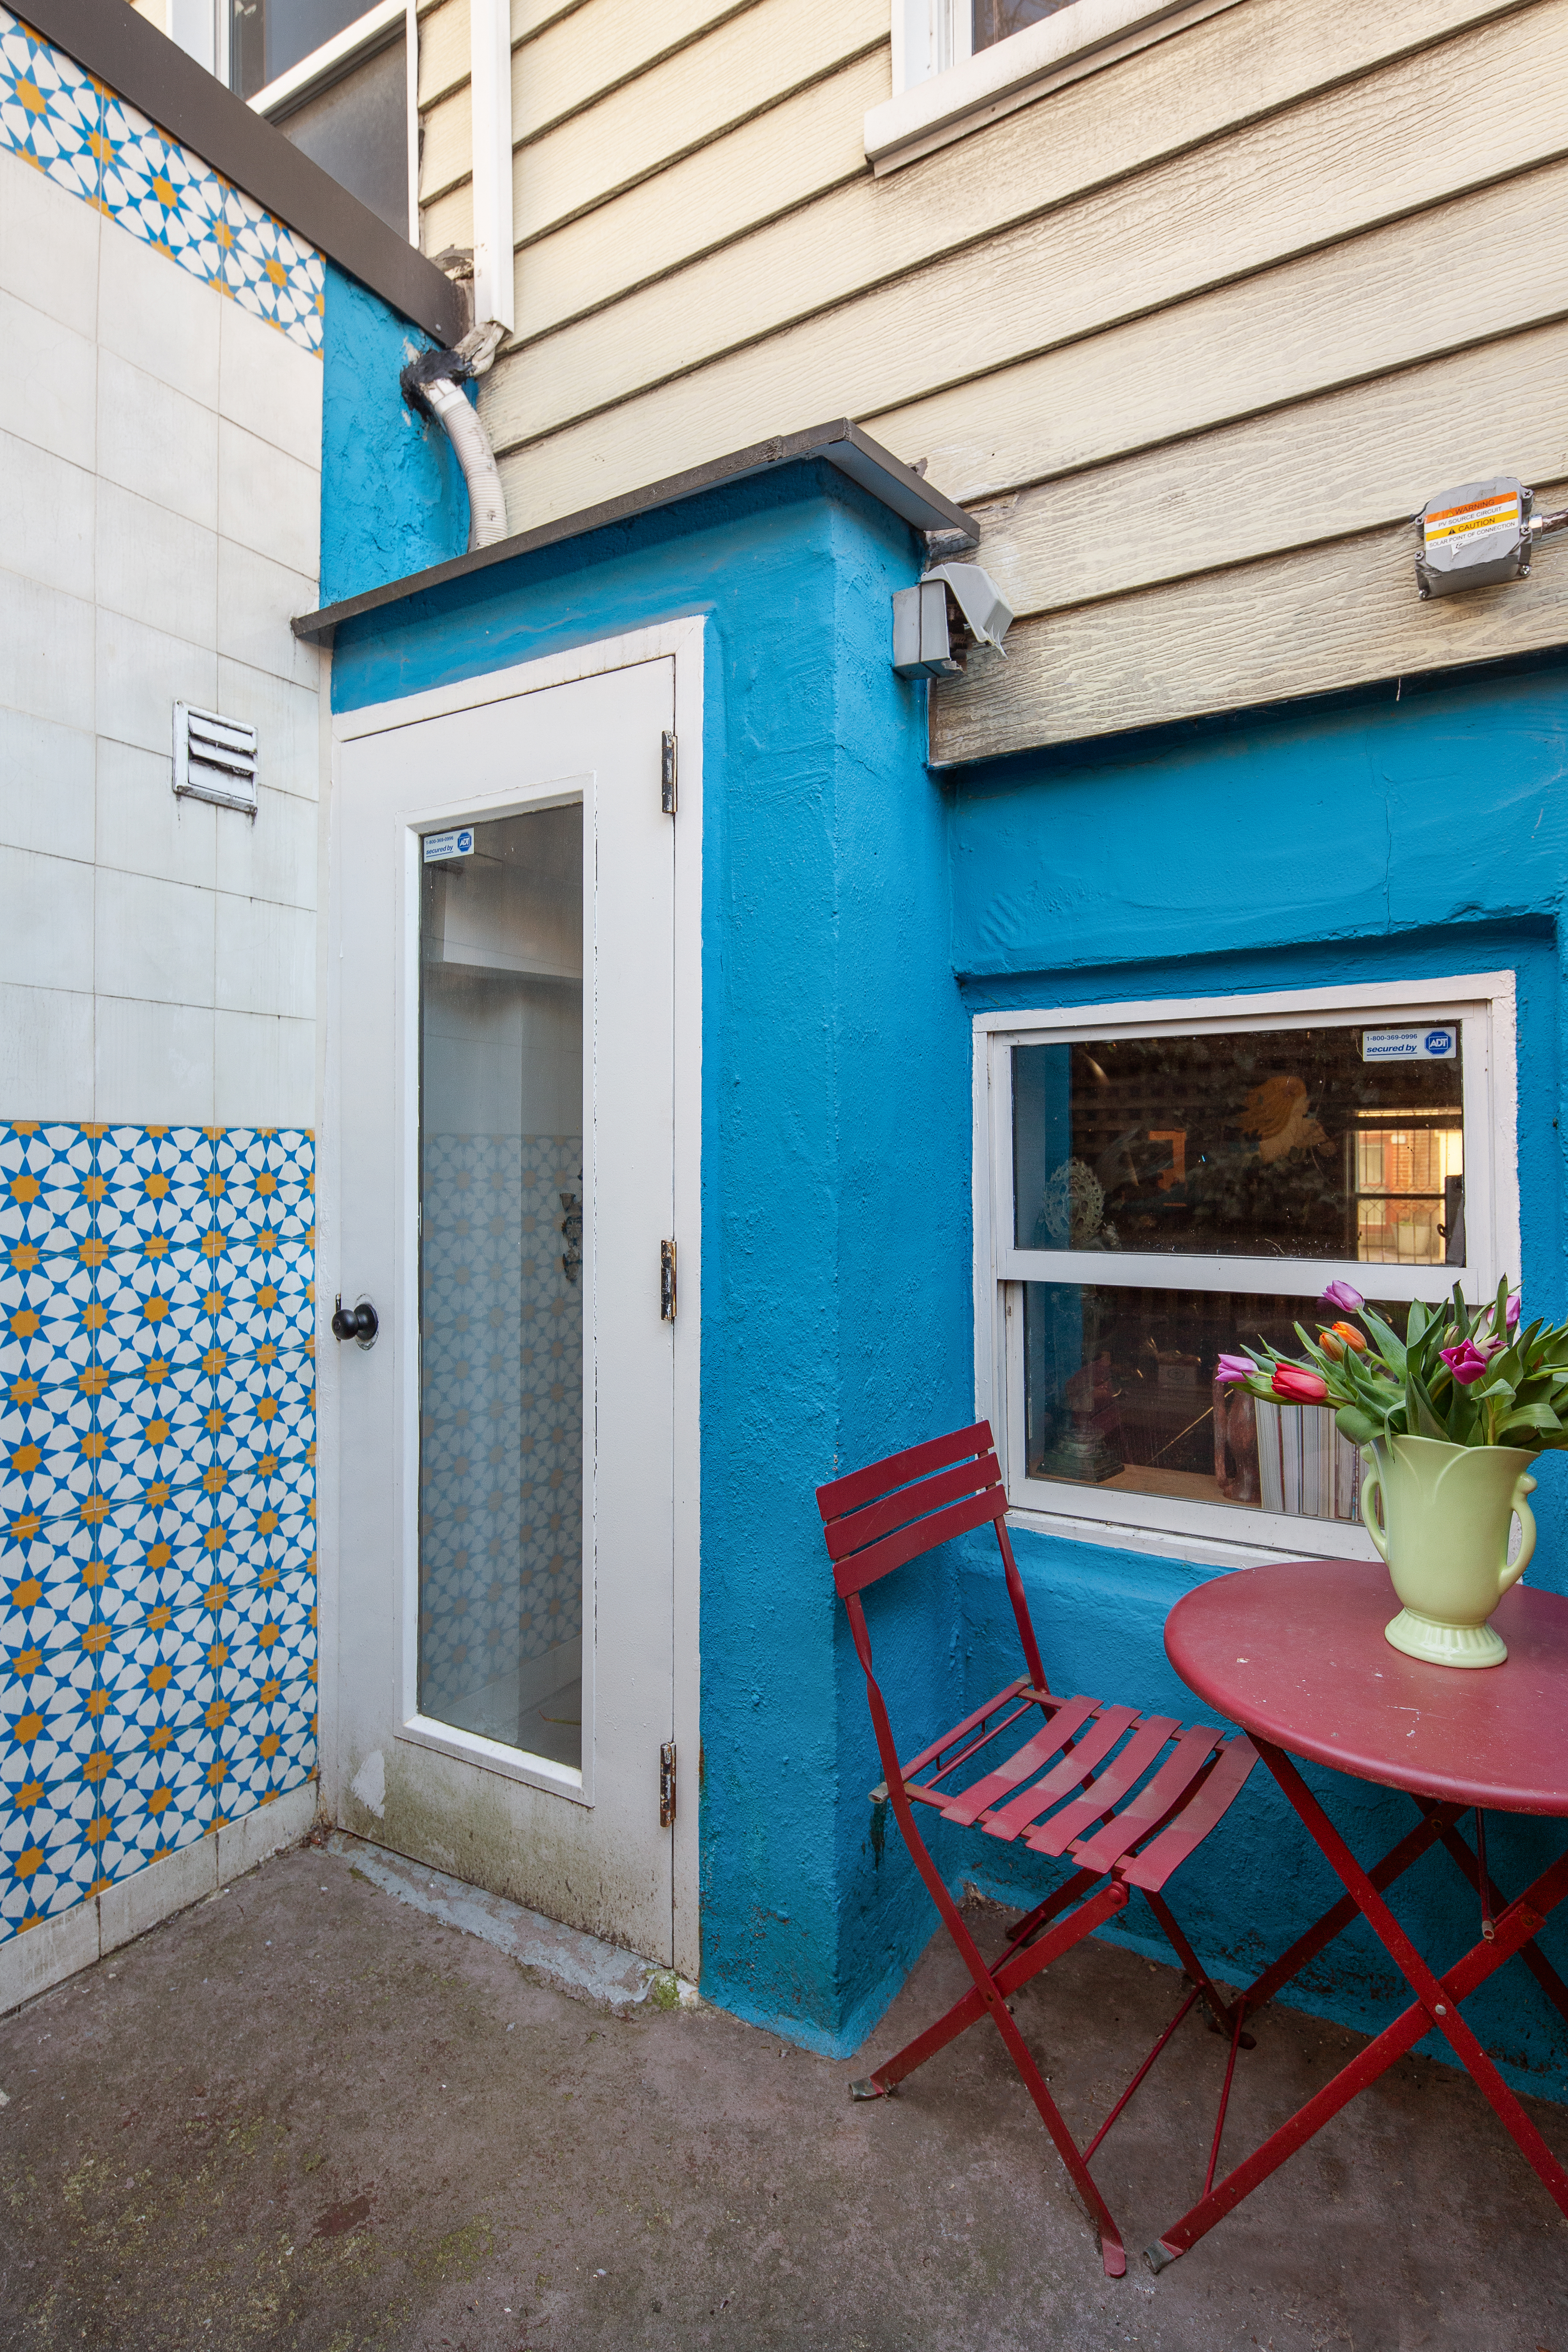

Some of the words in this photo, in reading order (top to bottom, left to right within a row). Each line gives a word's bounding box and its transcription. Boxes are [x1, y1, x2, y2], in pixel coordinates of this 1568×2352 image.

[1455, 499, 1494, 514] WARNING
[1448, 514, 1474, 525] SOURCE
[1477, 506, 1502, 517] CIRCUIT
[1459, 518, 1495, 532] CAUTION
[1430, 539, 1448, 548] SOLAR
[1477, 522, 1515, 535] CONNECTION
[426, 836, 454, 845] 1-800-369-0996
[460, 838, 470, 846] ADT
[426, 845, 446, 855] secured
[1429, 1038, 1447, 1047] ADT
[1366, 1045, 1404, 1053] secured
